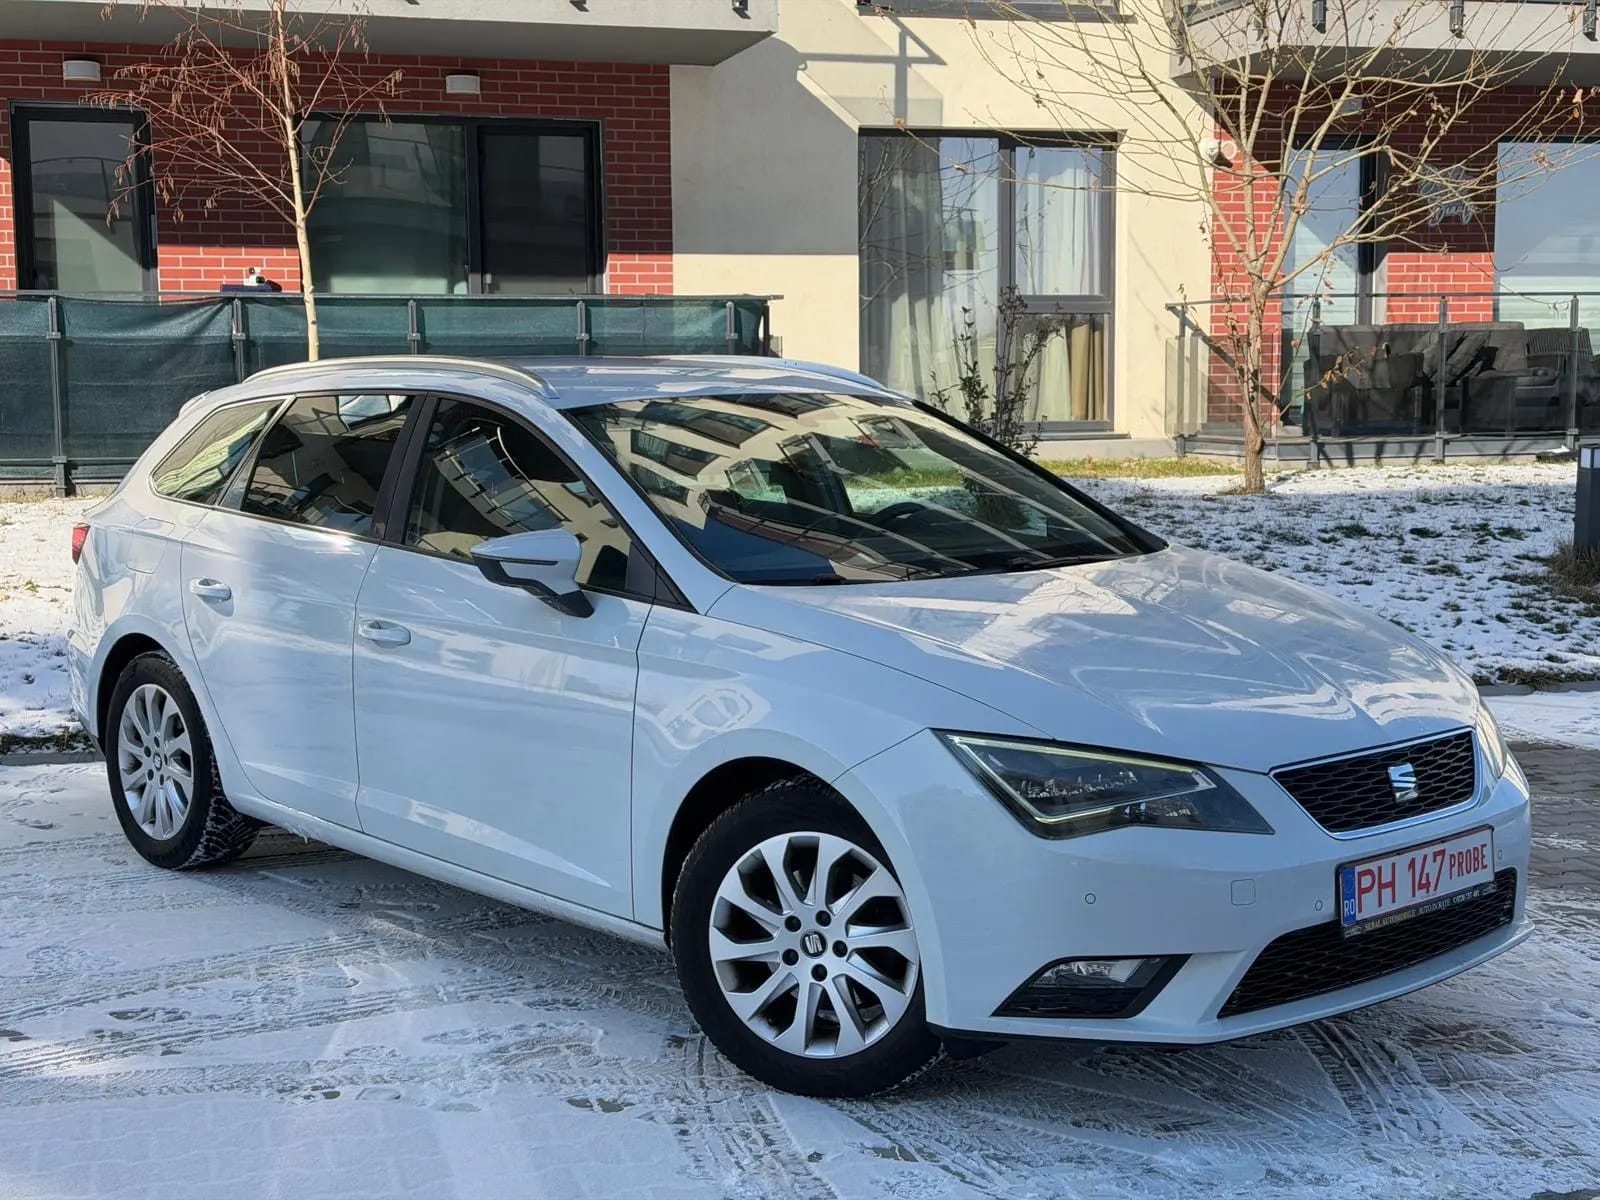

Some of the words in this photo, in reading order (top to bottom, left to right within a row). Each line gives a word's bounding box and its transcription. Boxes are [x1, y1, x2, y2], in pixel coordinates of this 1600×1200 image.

[1357, 862, 1396, 913] PH
[1408, 848, 1446, 898] 147
[1449, 843, 1488, 880] PROBE
[1344, 899, 1355, 916] RO
